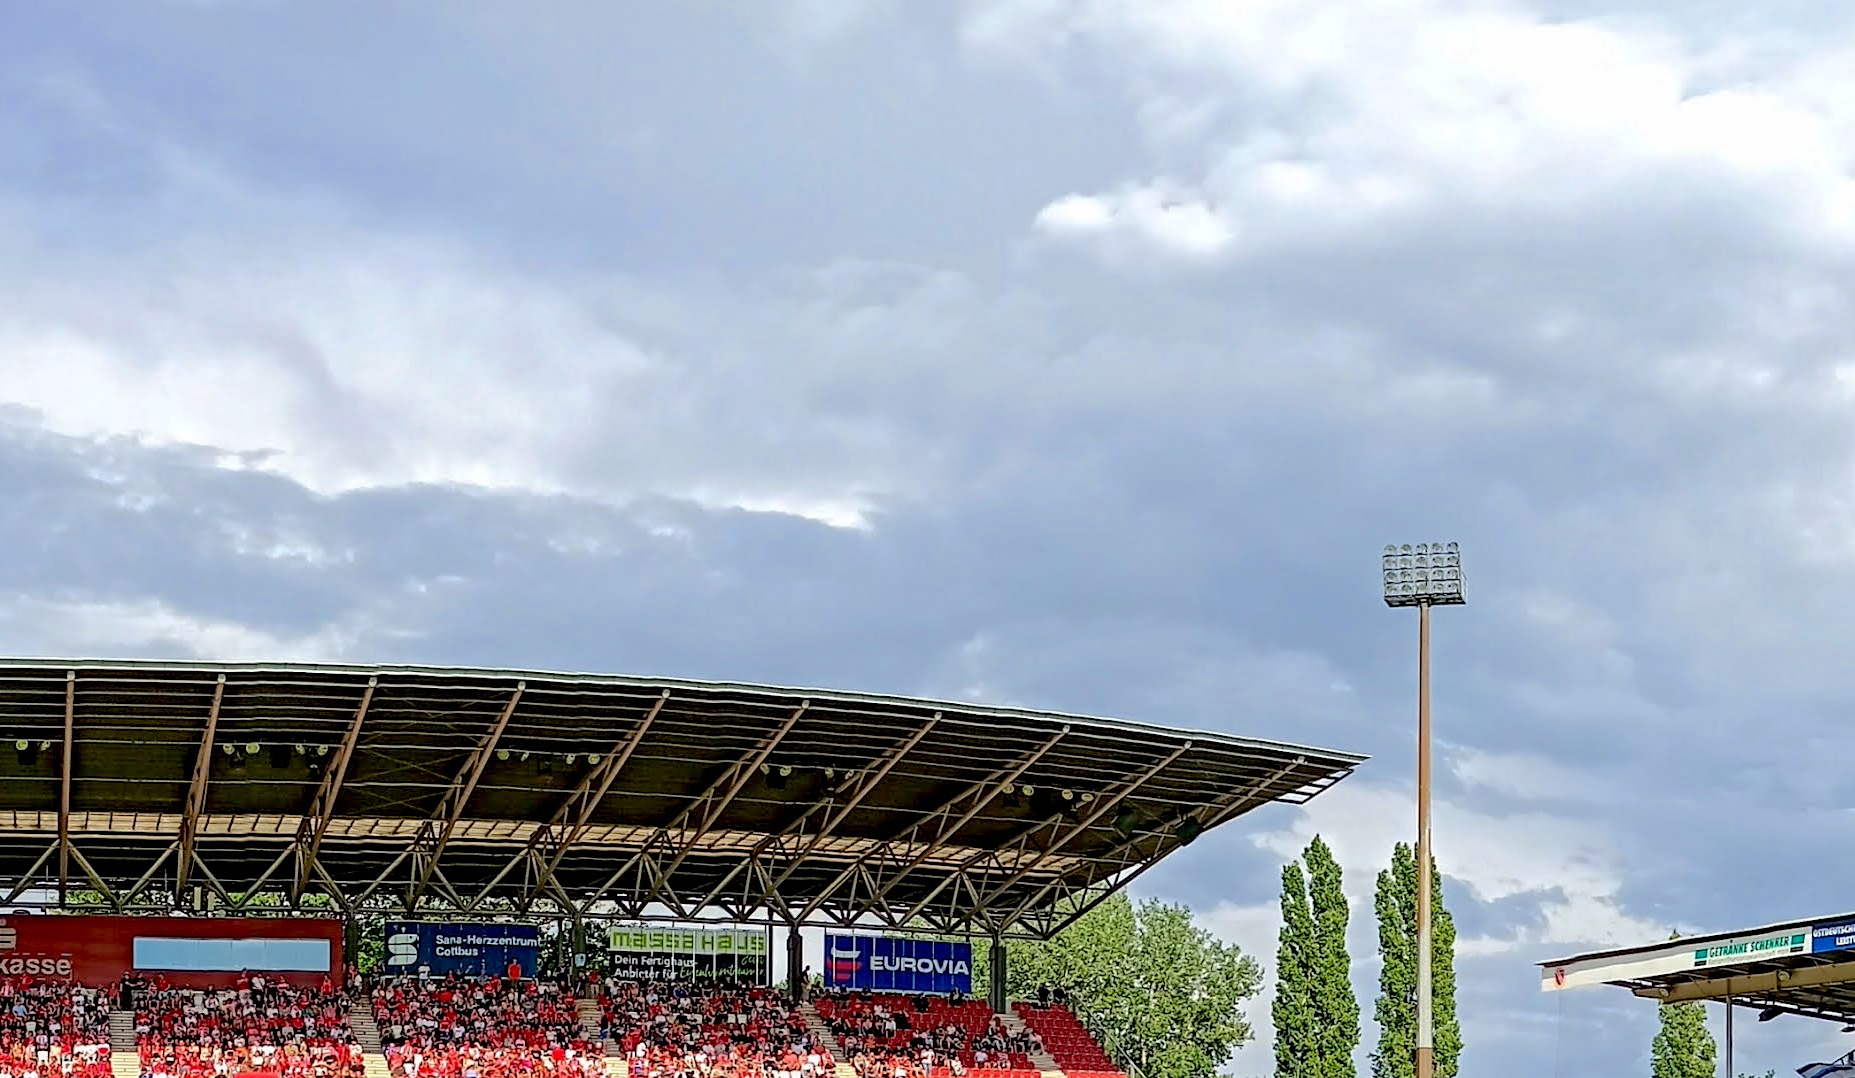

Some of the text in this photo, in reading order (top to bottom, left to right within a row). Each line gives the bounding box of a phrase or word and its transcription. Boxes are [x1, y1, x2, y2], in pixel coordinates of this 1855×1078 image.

[436, 945, 479, 957] Cottbus
[615, 955, 637, 966] Dein
[870, 955, 969, 976] EUROVIA
[615, 967, 679, 979] Anbieter für
